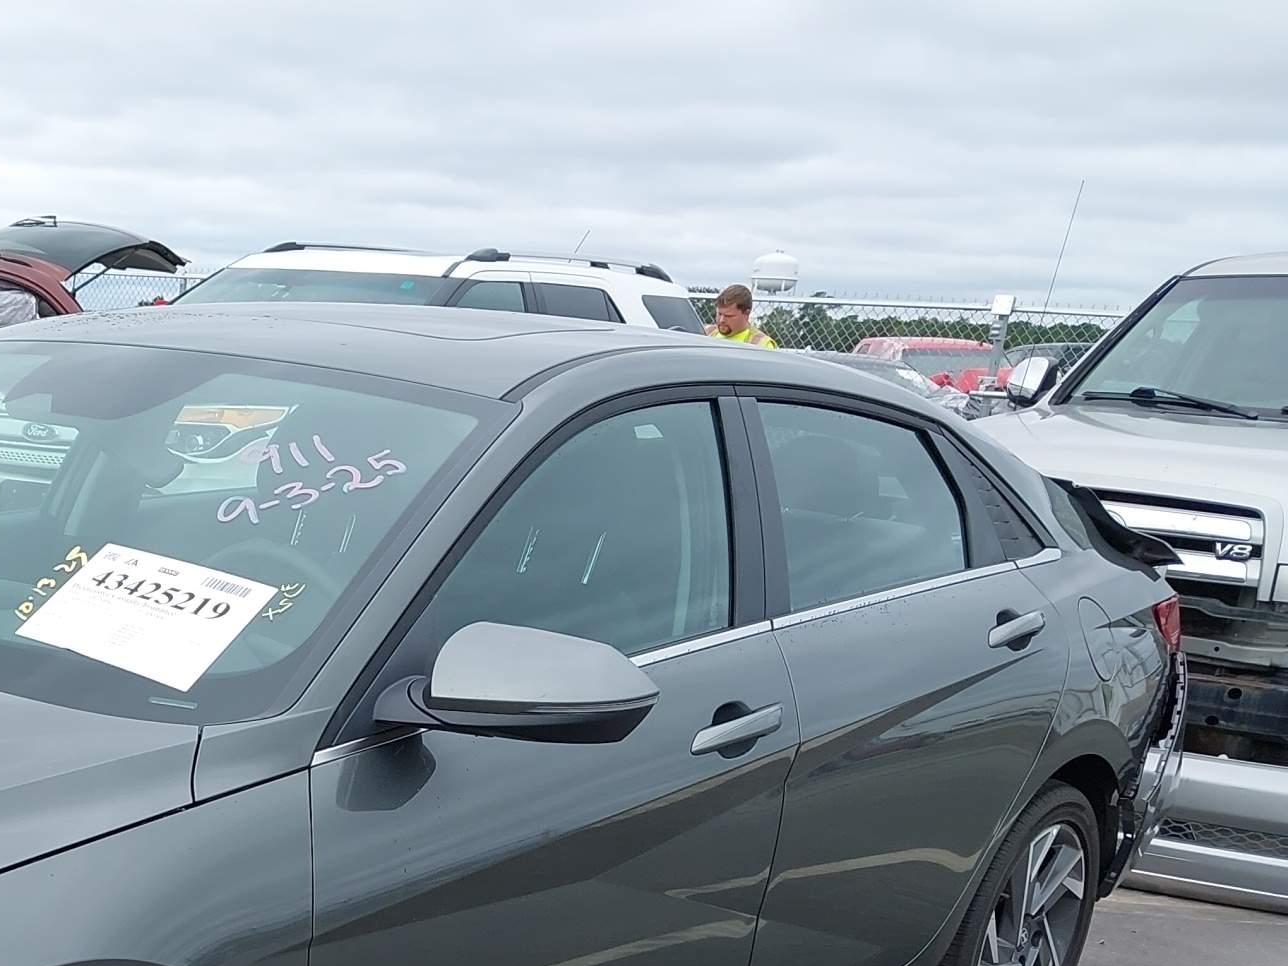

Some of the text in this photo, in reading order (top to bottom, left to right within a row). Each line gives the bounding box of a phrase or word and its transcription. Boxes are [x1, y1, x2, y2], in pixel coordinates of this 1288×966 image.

[27, 424, 49, 437] Ford
[216, 449, 407, 525] 9-3-25
[1215, 541, 1253, 559] V8
[91, 570, 231, 620] 43425219
